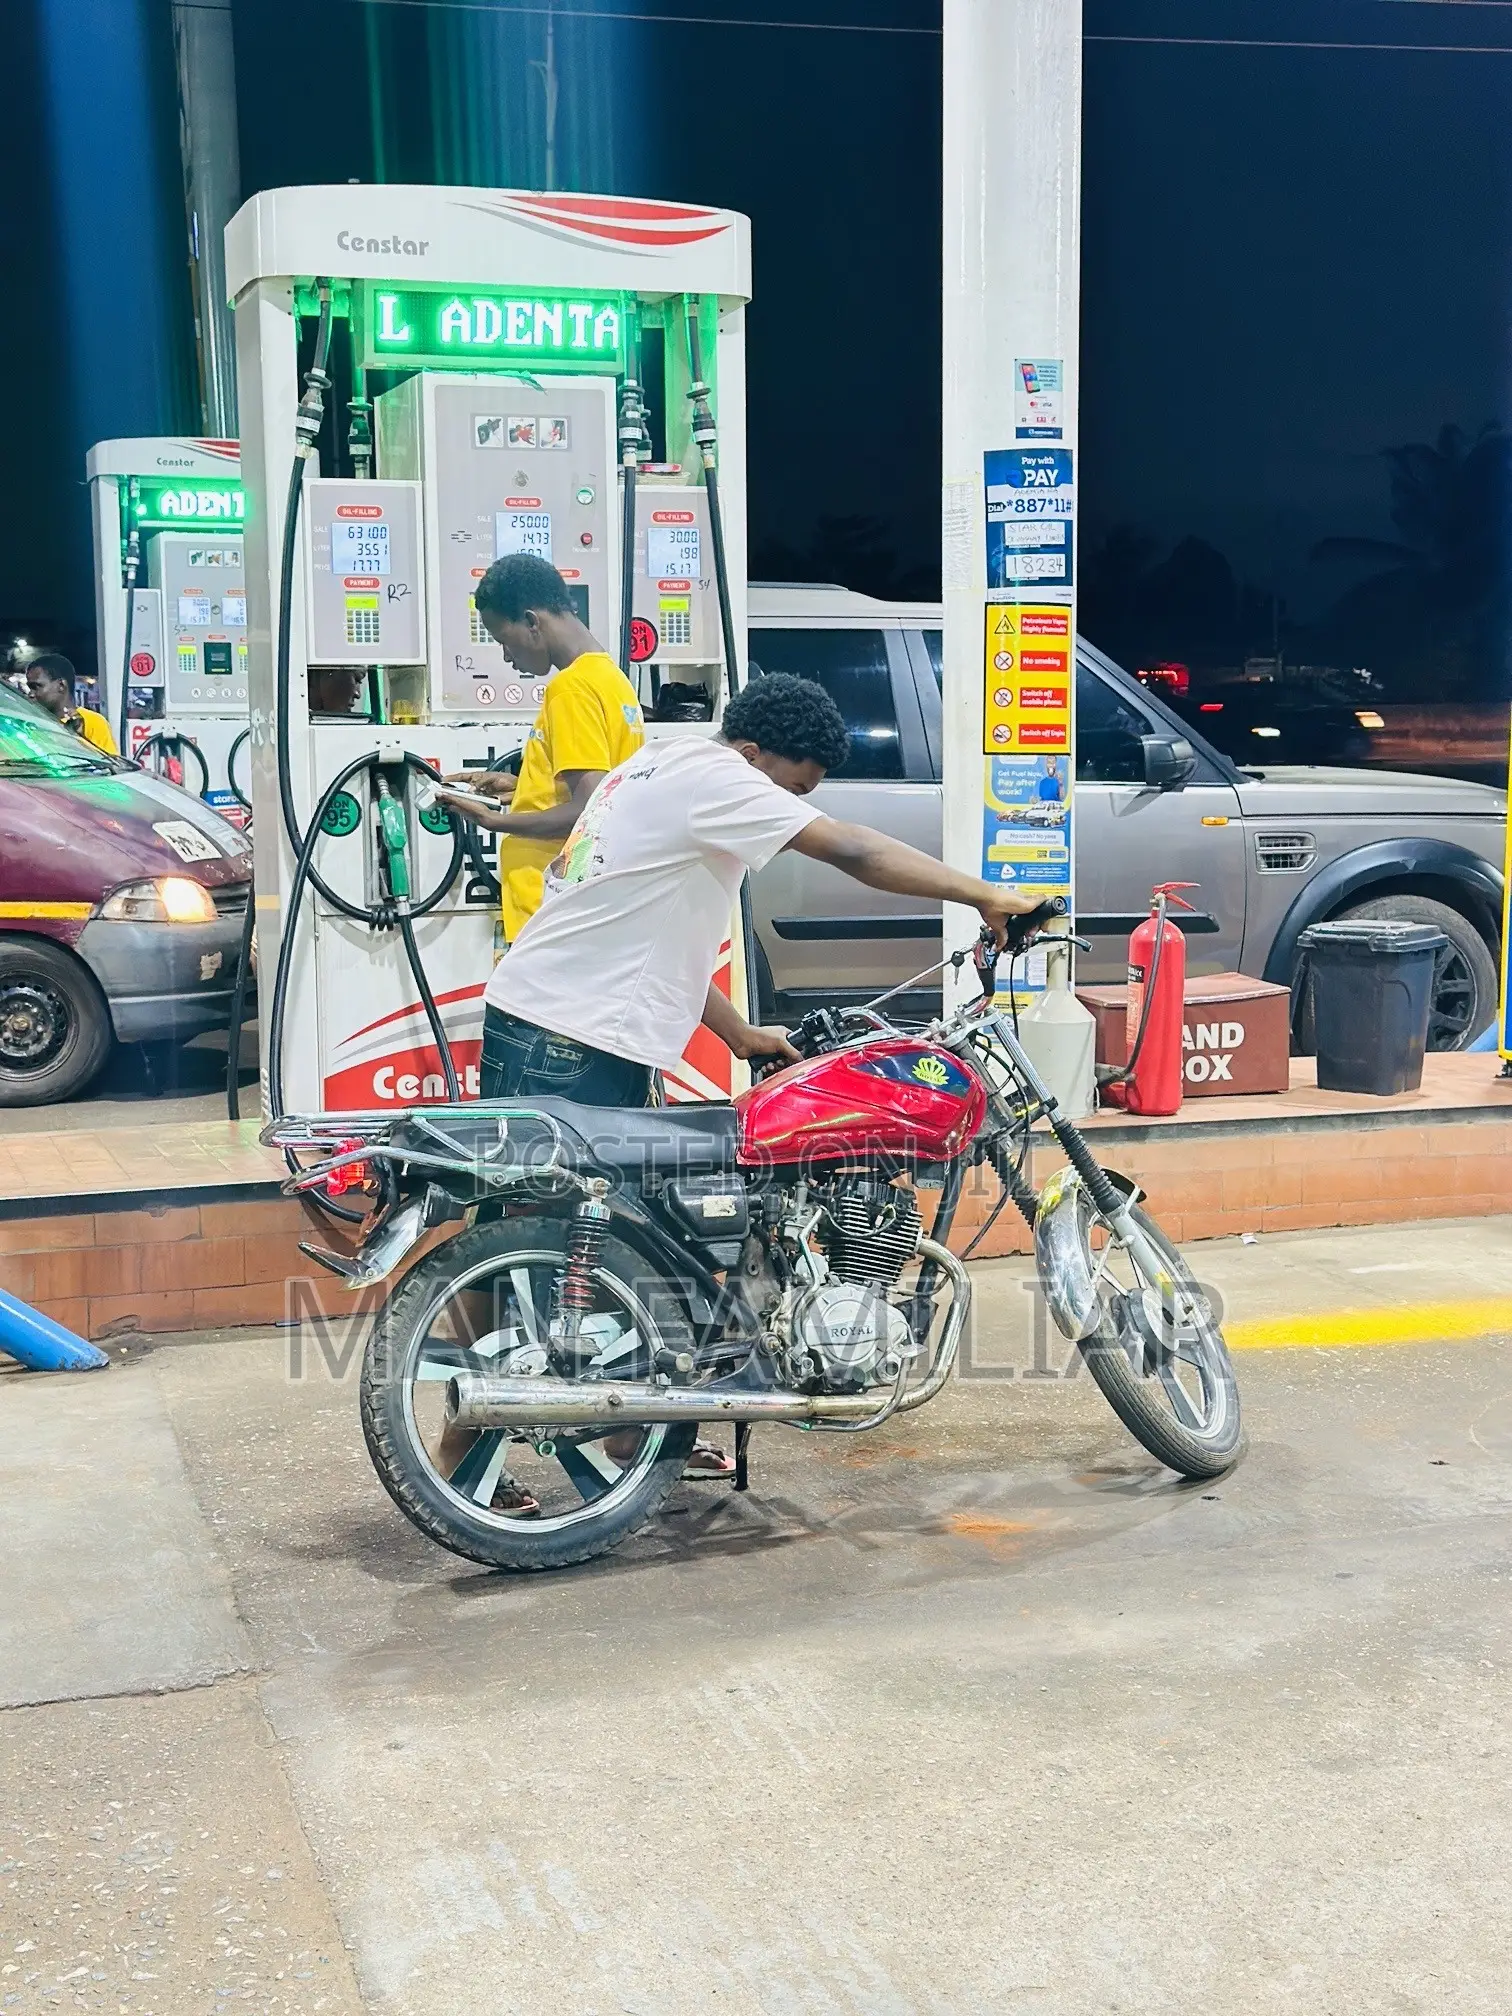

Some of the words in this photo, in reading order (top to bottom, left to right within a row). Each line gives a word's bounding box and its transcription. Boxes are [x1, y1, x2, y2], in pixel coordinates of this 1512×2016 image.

[337, 230, 430, 256] Censtar
[377, 295, 410, 342] L
[441, 299, 620, 349] ADENTA
[156, 457, 195, 467] Censtar
[1021, 456, 1037, 466] Pay
[1037, 456, 1055, 465] with
[1023, 468, 1059, 487] PAY
[160, 490, 245, 518] ADENT
[1013, 556, 1063, 575] 18234
[387, 583, 412, 604] R2
[631, 626, 647, 634] ON
[630, 636, 650, 654] 91
[455, 655, 475, 672] R2
[1022, 657, 1035, 665] No
[1035, 657, 1061, 667] smoking
[1021, 689, 1044, 697] Switch
[998, 779, 1014, 788] Pay
[1015, 778, 1037, 787] after
[326, 809, 350, 828] 95
[428, 806, 450, 826] 95
[463, 746, 502, 904] DIEL
[1182, 1022, 1245, 1050] AND
[1181, 1054, 1234, 1083] OX
[831, 1325, 874, 1338] ROYAL
